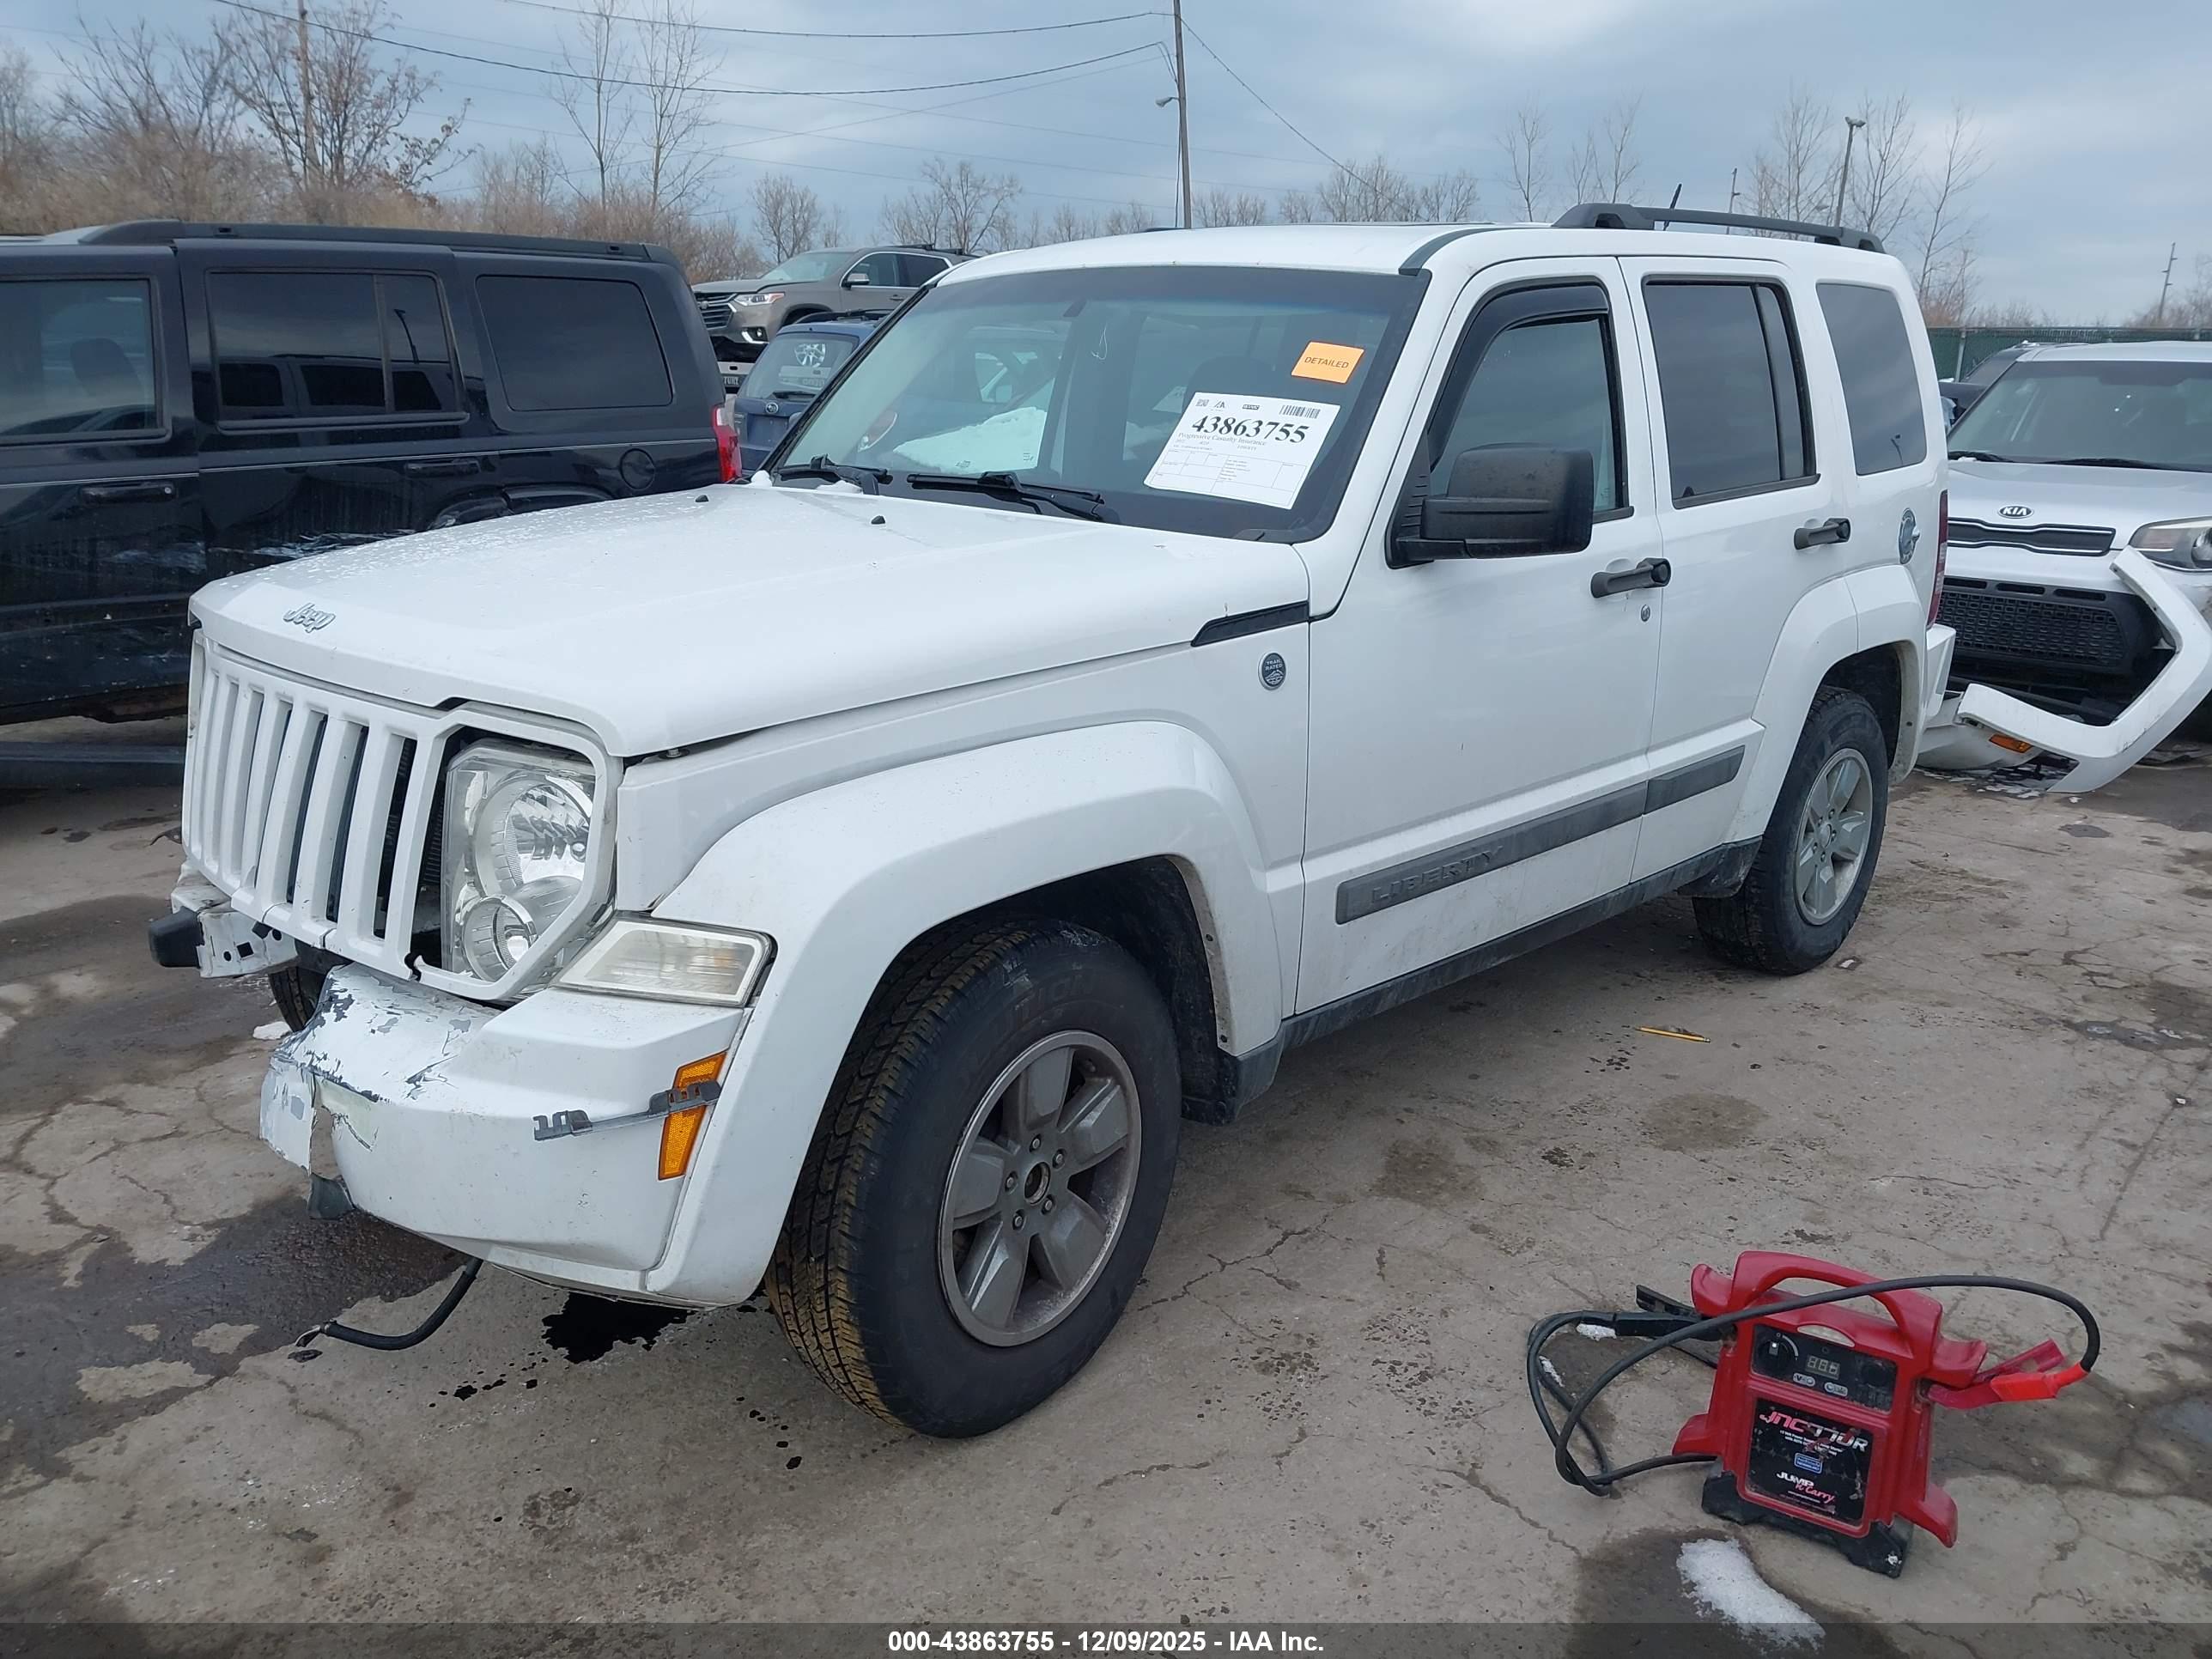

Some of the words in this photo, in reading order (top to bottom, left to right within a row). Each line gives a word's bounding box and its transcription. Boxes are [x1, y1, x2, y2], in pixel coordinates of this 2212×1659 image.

[1304, 356, 1349, 368] DETAILED
[1192, 416, 1310, 443] 43863755
[2002, 507, 2027, 516] KIA
[283, 602, 337, 634] Jeep
[1371, 845, 1503, 902] LIBERTY
[1776, 1471, 1814, 1487] JUMP
[1805, 1486, 1836, 1504] Carry
